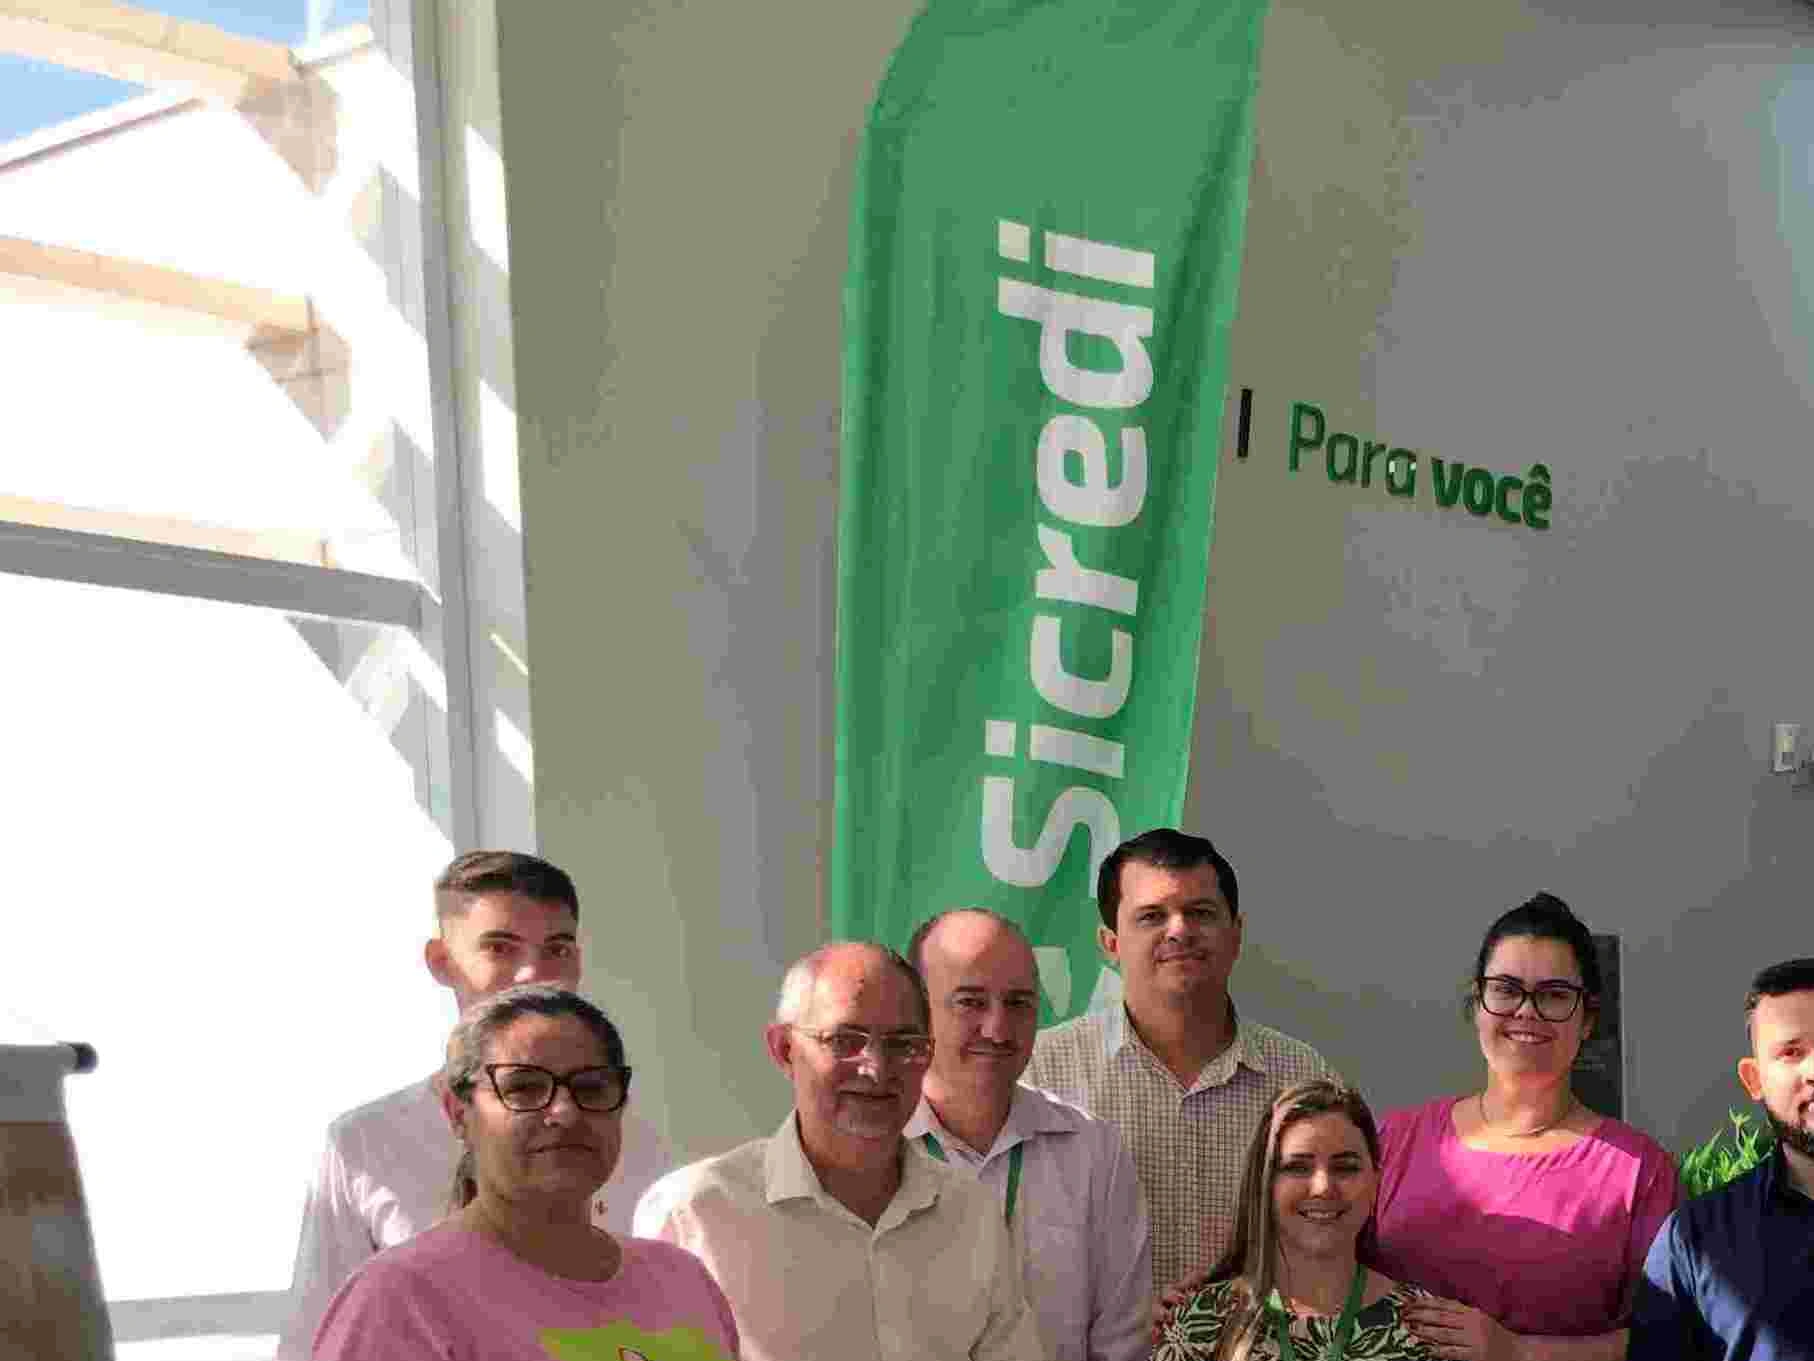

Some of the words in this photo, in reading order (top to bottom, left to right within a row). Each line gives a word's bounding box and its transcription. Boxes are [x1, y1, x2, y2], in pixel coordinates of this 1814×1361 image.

[981, 219, 1155, 898] Sicredi
[1288, 402, 1416, 498] Para
[1431, 455, 1552, 530] você
